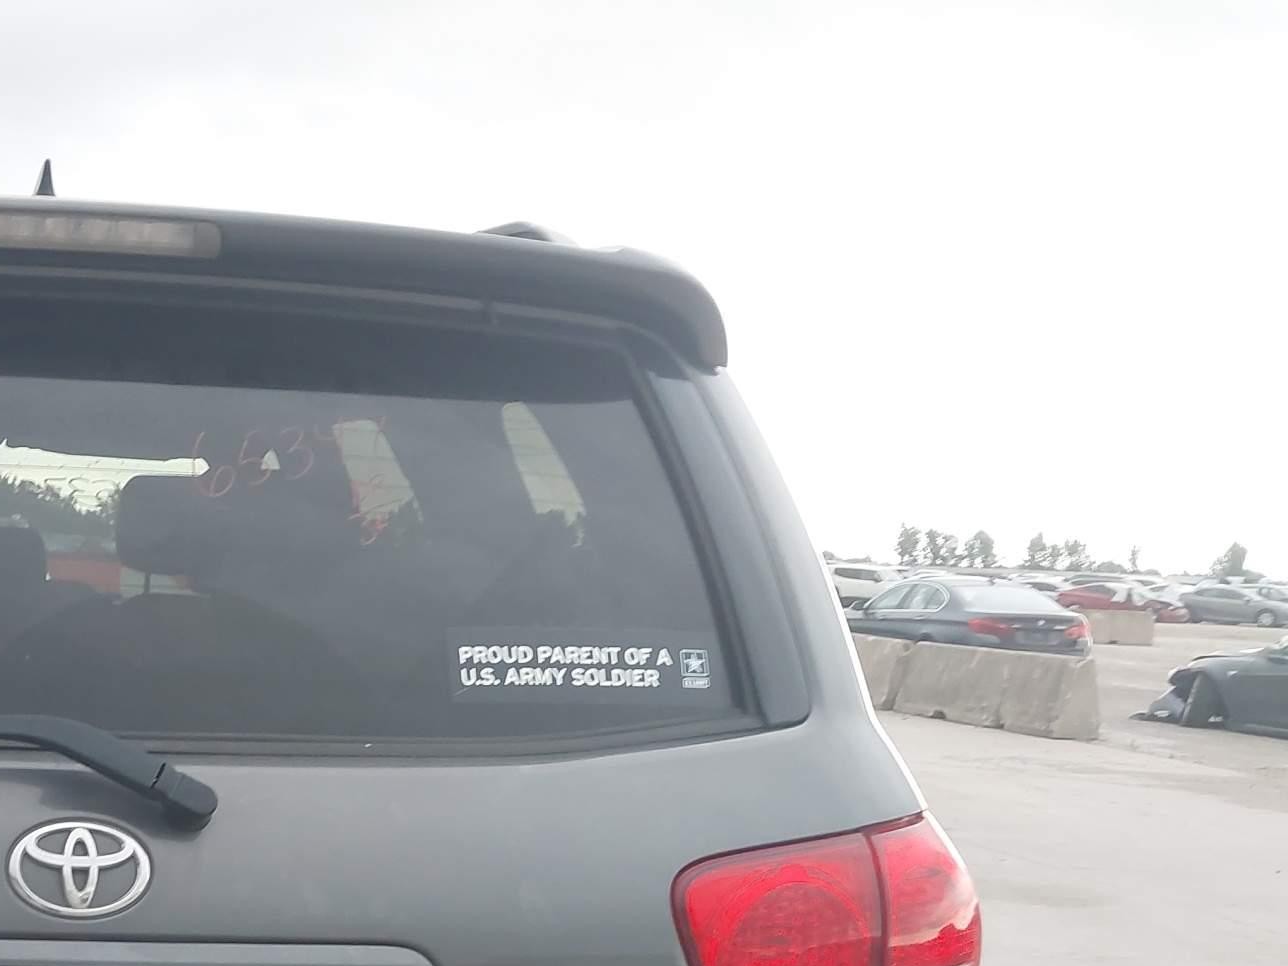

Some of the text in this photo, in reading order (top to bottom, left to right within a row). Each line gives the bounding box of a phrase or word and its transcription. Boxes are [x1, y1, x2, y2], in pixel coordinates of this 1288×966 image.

[458, 646, 674, 666] PROUD PARENT OF A
[460, 668, 661, 687] U.S. ARMY SOLDIER
